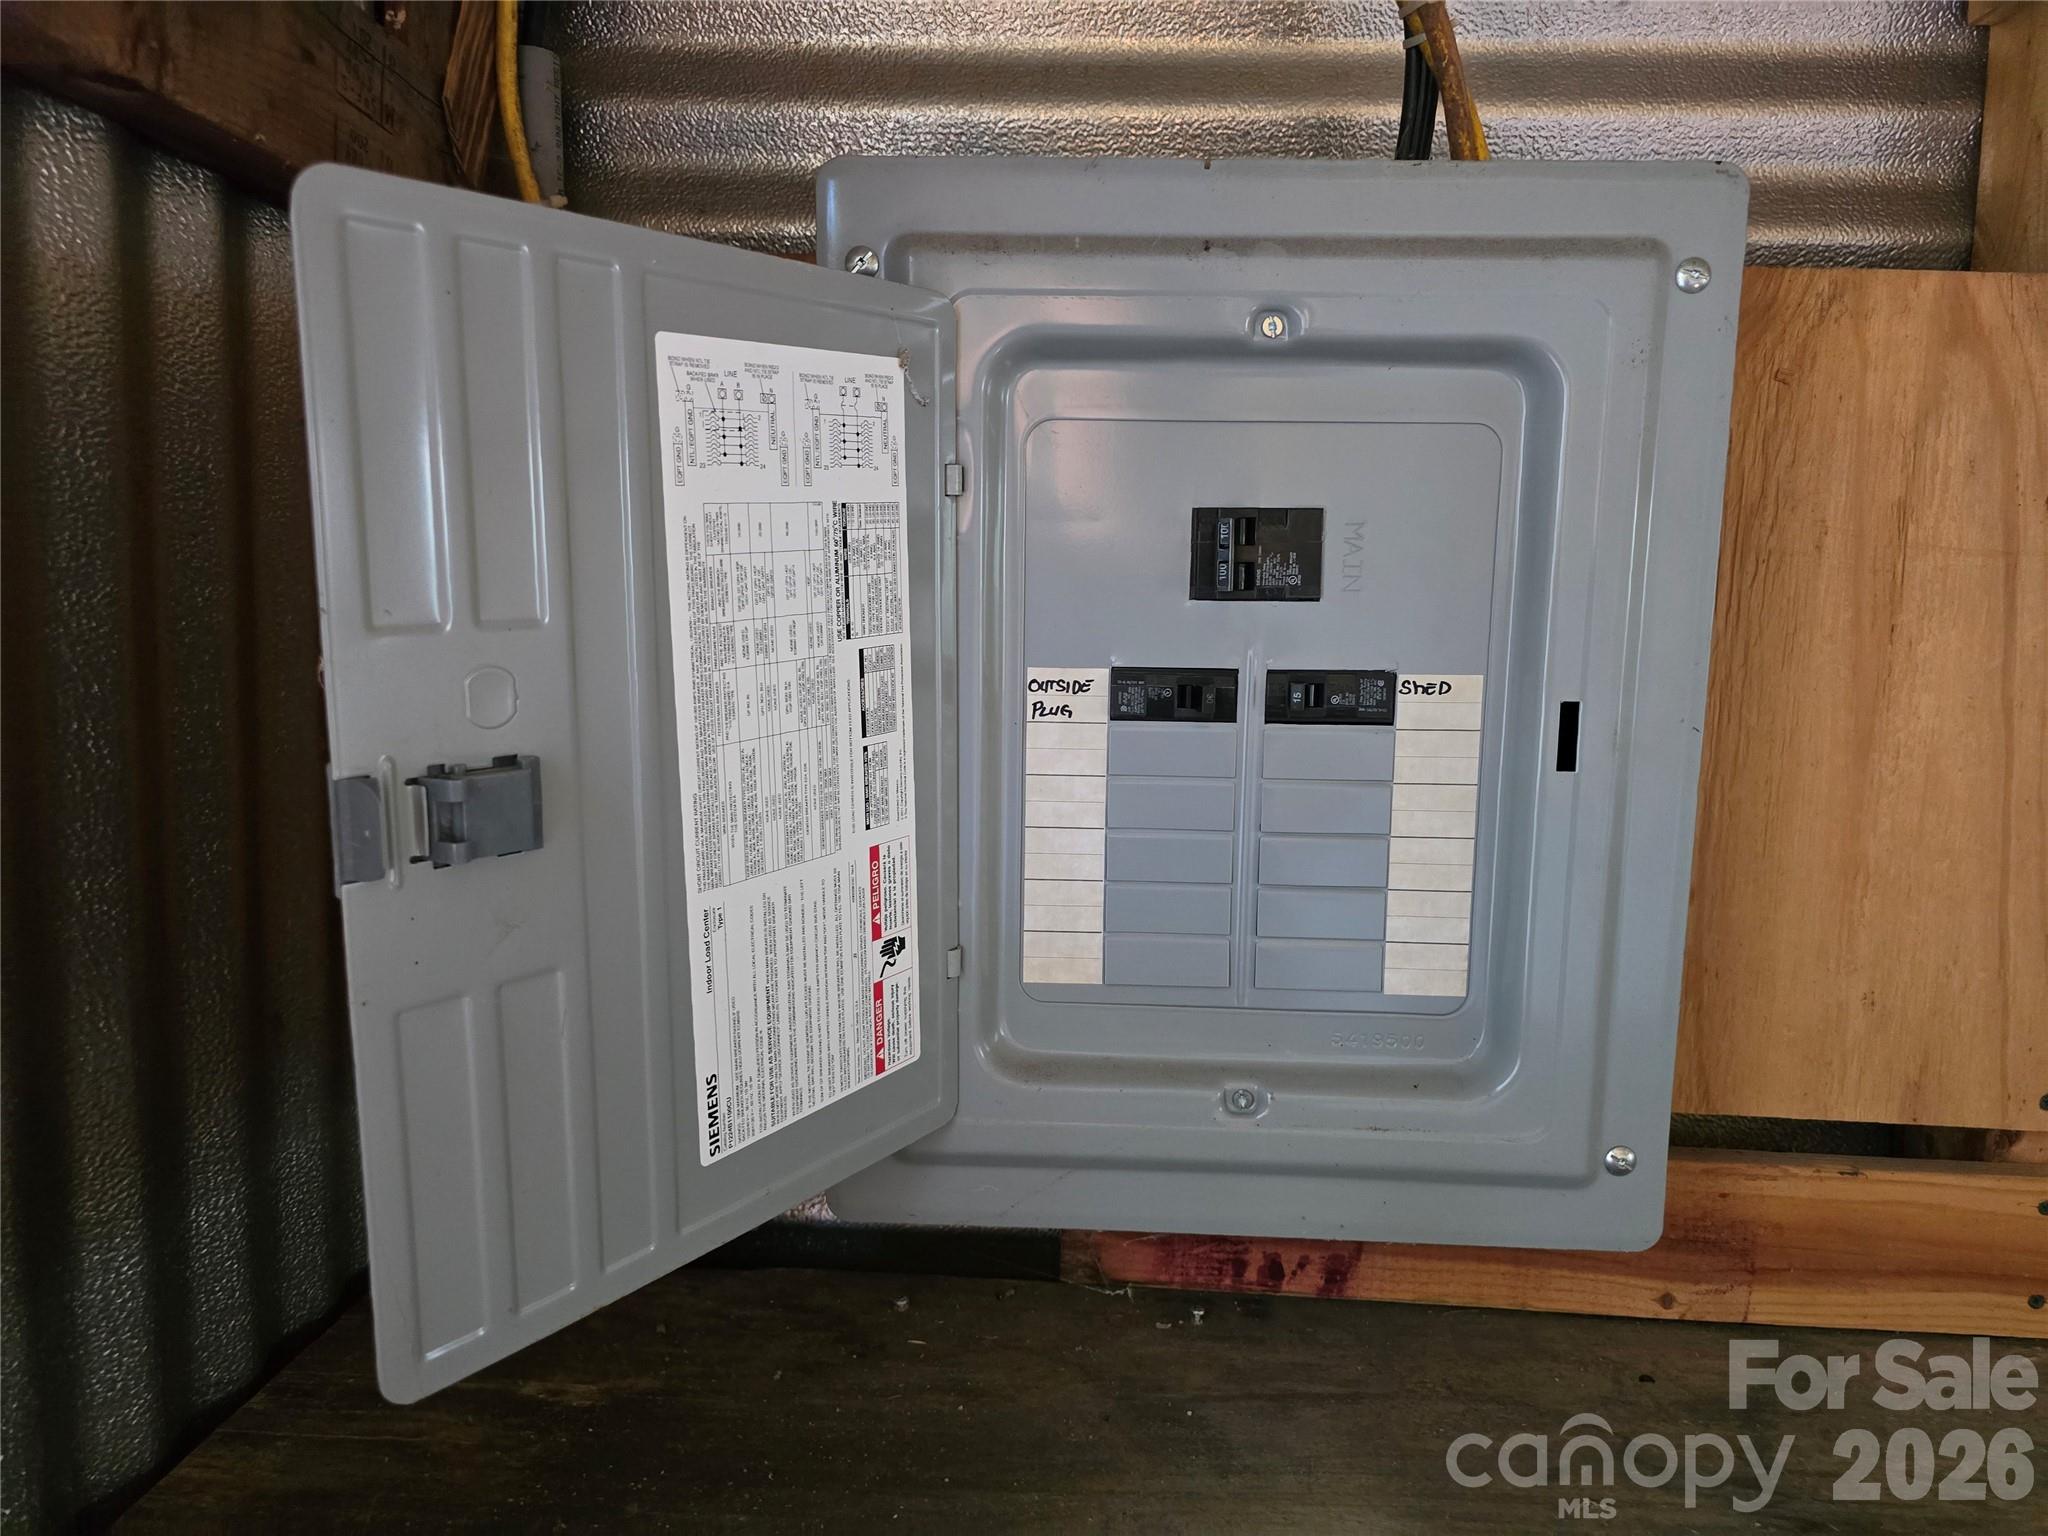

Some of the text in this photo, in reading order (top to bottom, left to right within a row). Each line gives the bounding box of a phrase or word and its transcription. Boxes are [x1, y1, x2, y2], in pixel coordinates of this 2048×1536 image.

[1342, 521, 1368, 593] MAIN
[836, 586, 840, 596] OR
[1028, 678, 1094, 694] OUTSIDE
[1292, 692, 1302, 703] 15
[1032, 700, 1072, 720] PLUG
[871, 859, 880, 910] PELIGRO
[875, 997, 883, 1046] DANGER
[769, 1054, 773, 1065] AS
[706, 1072, 720, 1158] SIEMENS
